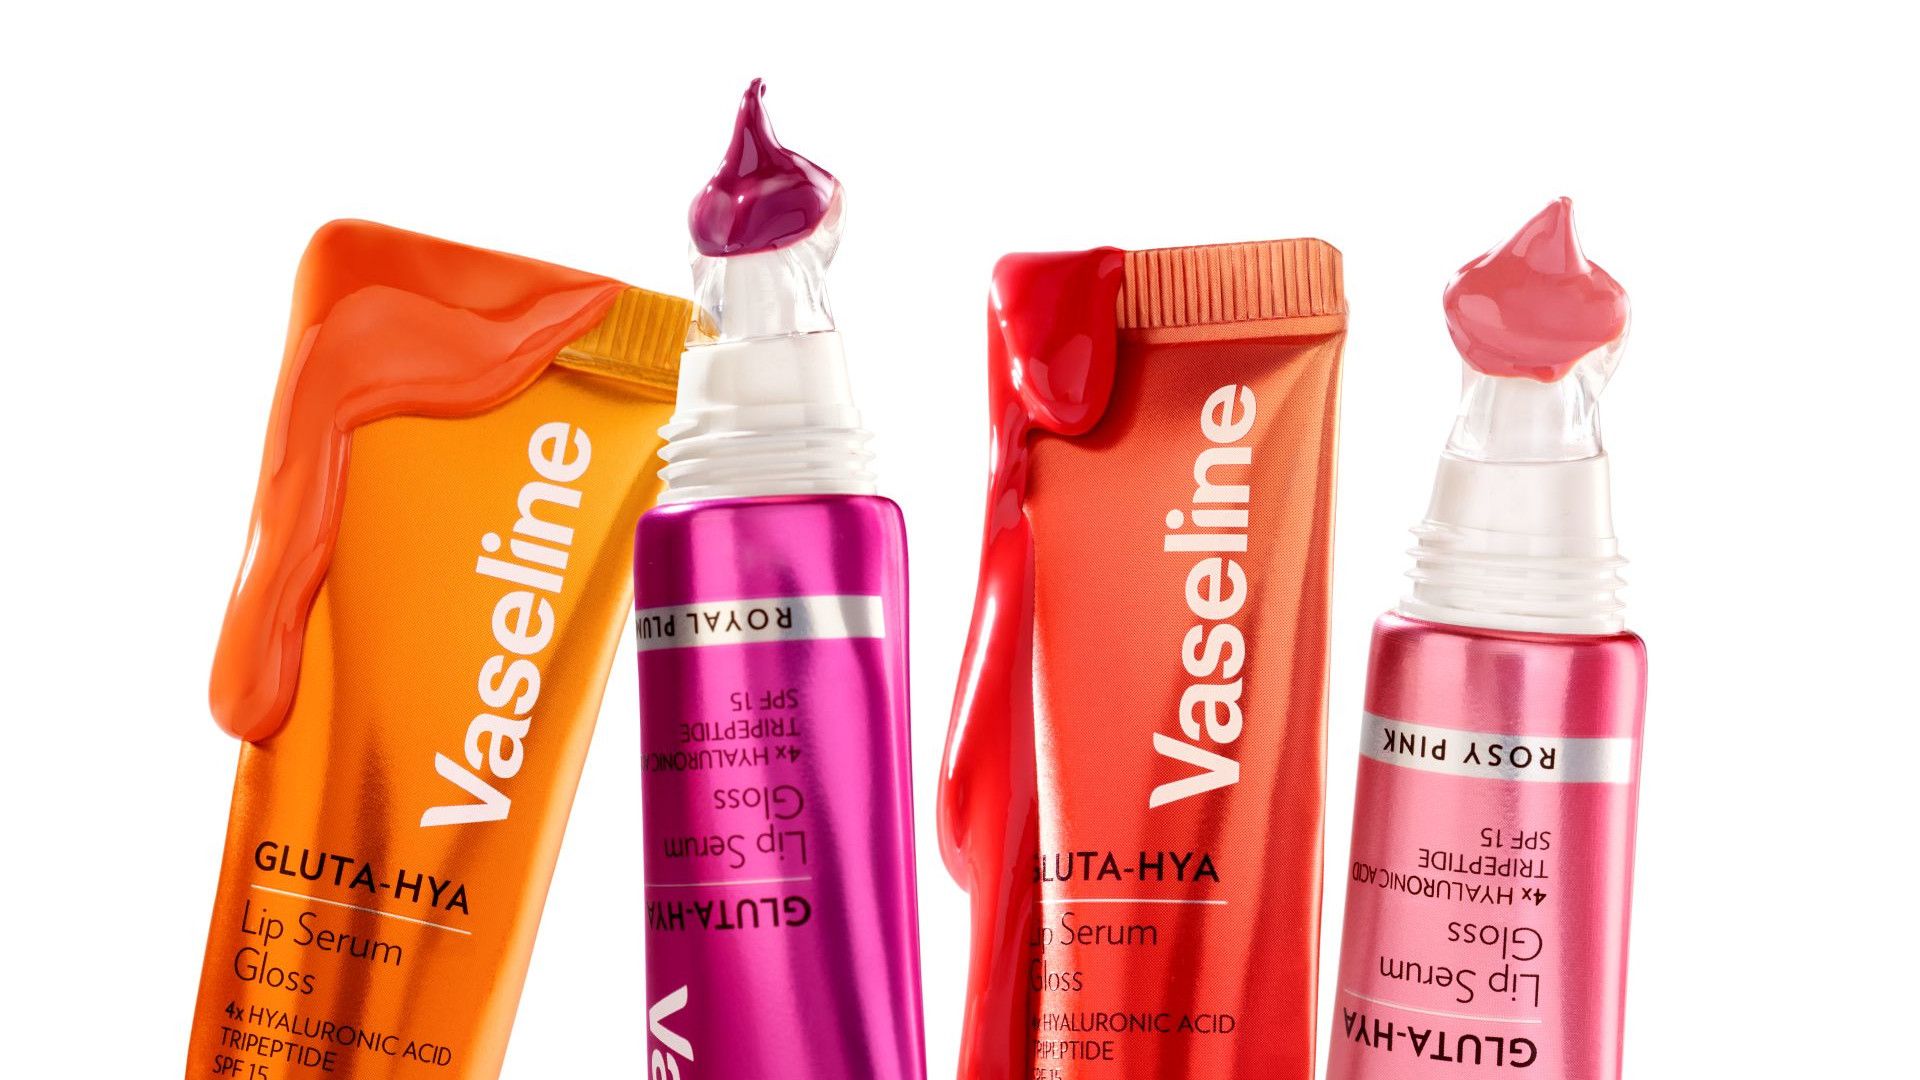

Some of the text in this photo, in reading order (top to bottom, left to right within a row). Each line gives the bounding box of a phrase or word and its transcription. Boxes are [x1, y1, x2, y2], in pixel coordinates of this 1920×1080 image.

[1149, 384, 1257, 809] Vaseline
[419, 421, 592, 828] Vaseline
[687, 607, 793, 634] ROYAL
[730, 688, 799, 711] SPF 15
[680, 717, 801, 744] TRIPEPTIDE
[1383, 728, 1556, 770] ROSY PINK
[651, 748, 768, 773] HYALURONIC
[776, 746, 801, 763] 4x
[714, 785, 804, 820] Gloss
[663, 824, 807, 869] Lip Serum
[1480, 827, 1552, 850] SPF 15
[254, 841, 469, 915] GLUTA-HYA
[1418, 848, 1549, 879] TRIPEPTIDE
[1352, 861, 1547, 906] 4x HYALURONIC ACID
[241, 899, 402, 966] Lip Serum
[648, 896, 812, 932] GLUTA-HYA
[1061, 911, 1158, 946] Serum
[1448, 921, 1543, 961] Gloss
[234, 947, 315, 995] Gloss
[1029, 957, 1083, 992] Gloss
[1380, 956, 1540, 1007] Lip Serum
[225, 1001, 452, 1067] 4x HYALURONIC ACID
[1043, 1012, 1171, 1034] HYALURONIC
[1176, 1013, 1236, 1034] ACID
[1343, 1007, 1537, 1068] GLUTA-HYA
[212, 1054, 269, 1080] SPF 15
[221, 1026, 337, 1073] TRIPEPTIDE
